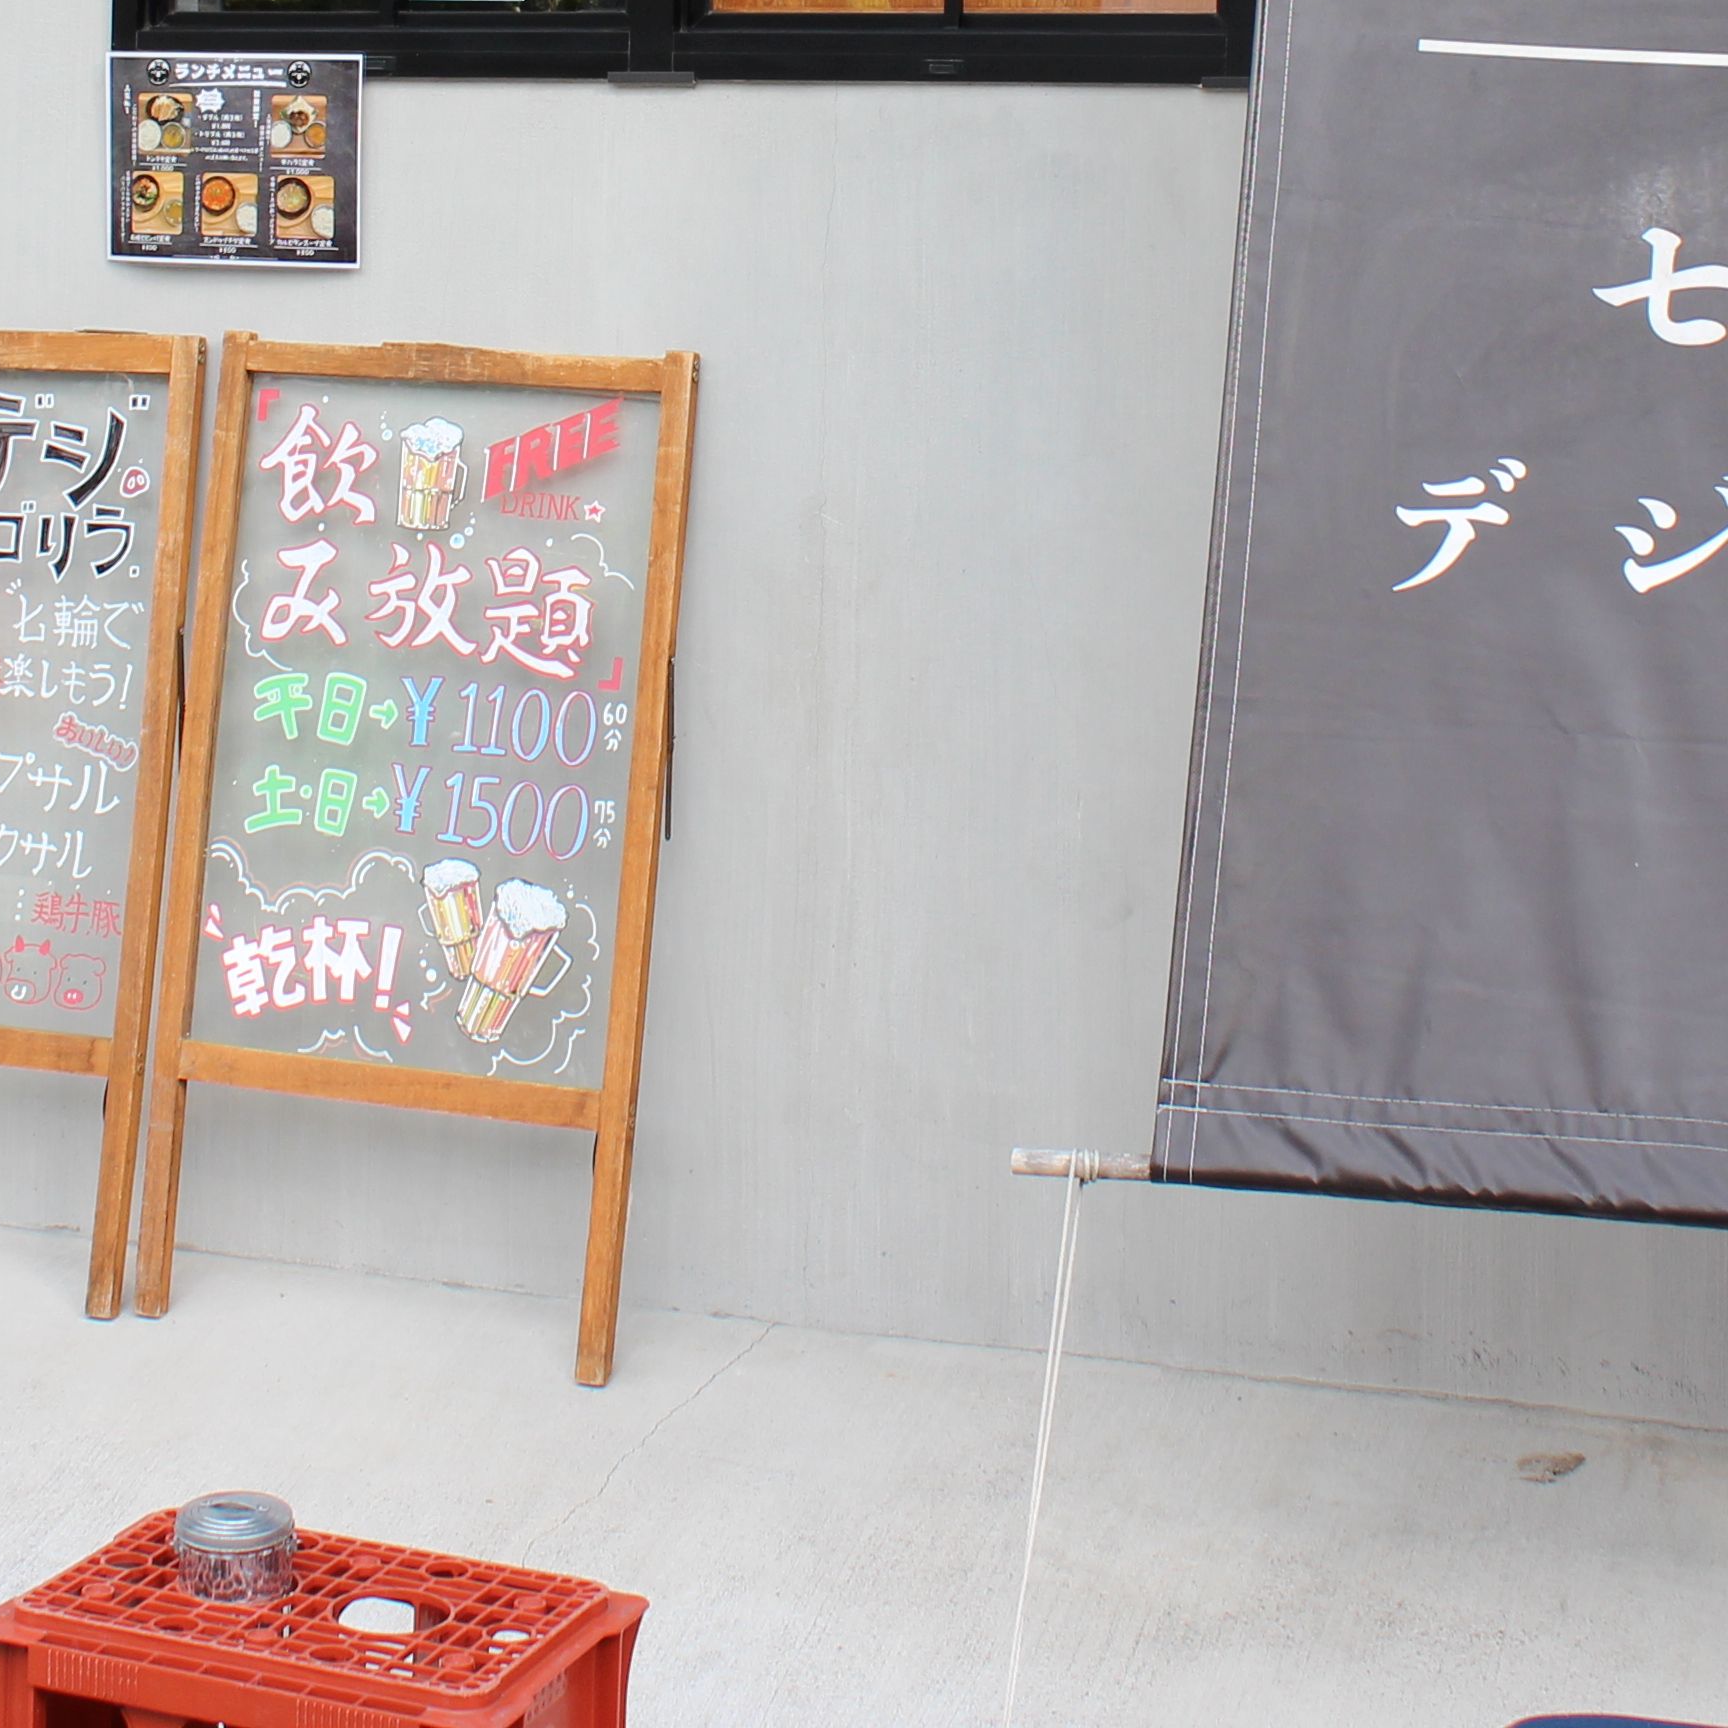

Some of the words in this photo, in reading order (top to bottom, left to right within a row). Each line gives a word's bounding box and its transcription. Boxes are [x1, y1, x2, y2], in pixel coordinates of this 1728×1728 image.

[174, 63, 285, 80] ランチメニュー
[481, 395, 624, 504] FREE
[499, 490, 581, 523] DRINK
[13, 593, 145, 650] 七輪で
[252, 670, 368, 746] 平日
[400, 675, 599, 767] ¥1100
[392, 763, 590, 862] ¥1500
[221, 913, 404, 1019] 乾杯!
